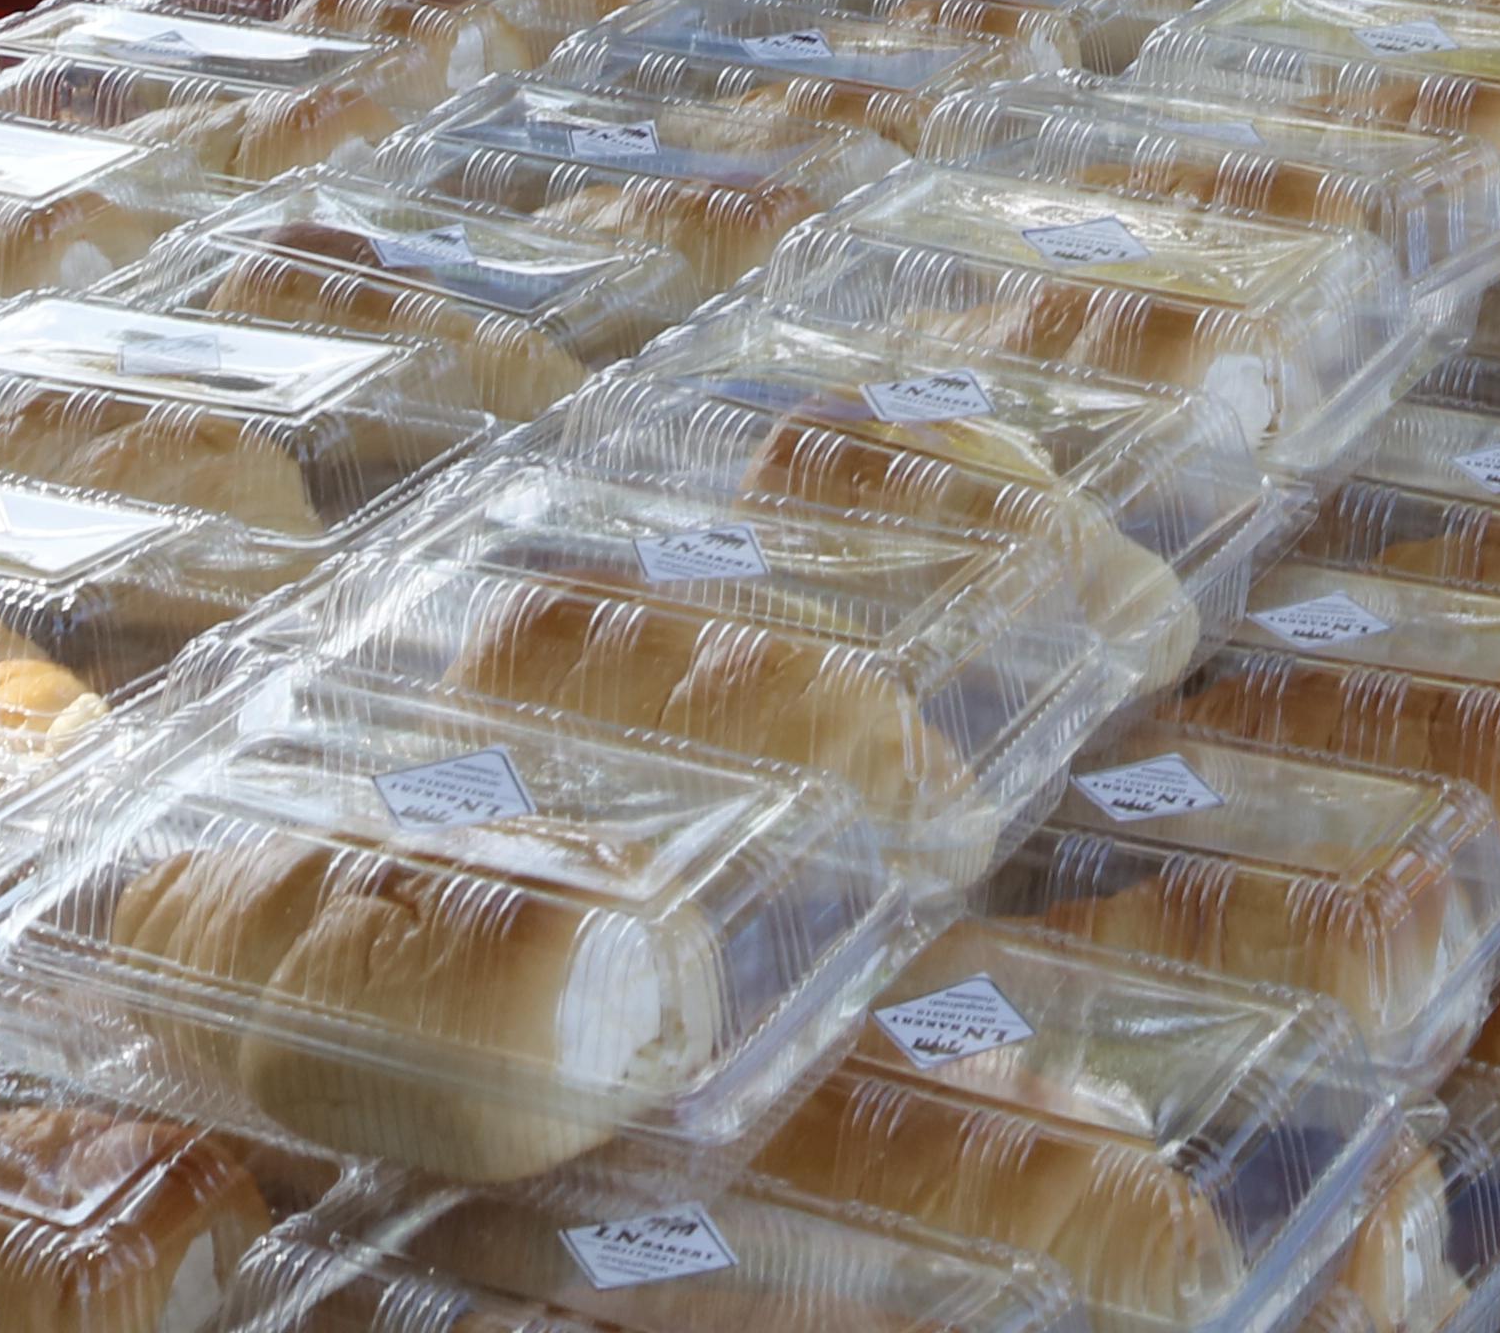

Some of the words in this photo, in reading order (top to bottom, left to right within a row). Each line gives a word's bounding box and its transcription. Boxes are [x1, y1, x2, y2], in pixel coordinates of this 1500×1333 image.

[389, 781, 455, 804] BAKERY
[1155, 793, 1197, 808] LN
[454, 798, 502, 818] LN
[890, 1014, 962, 1033] BAKERY
[961, 1024, 1008, 1045] LN
[594, 1225, 643, 1247] LN
[641, 1235, 715, 1261] BAKERY
